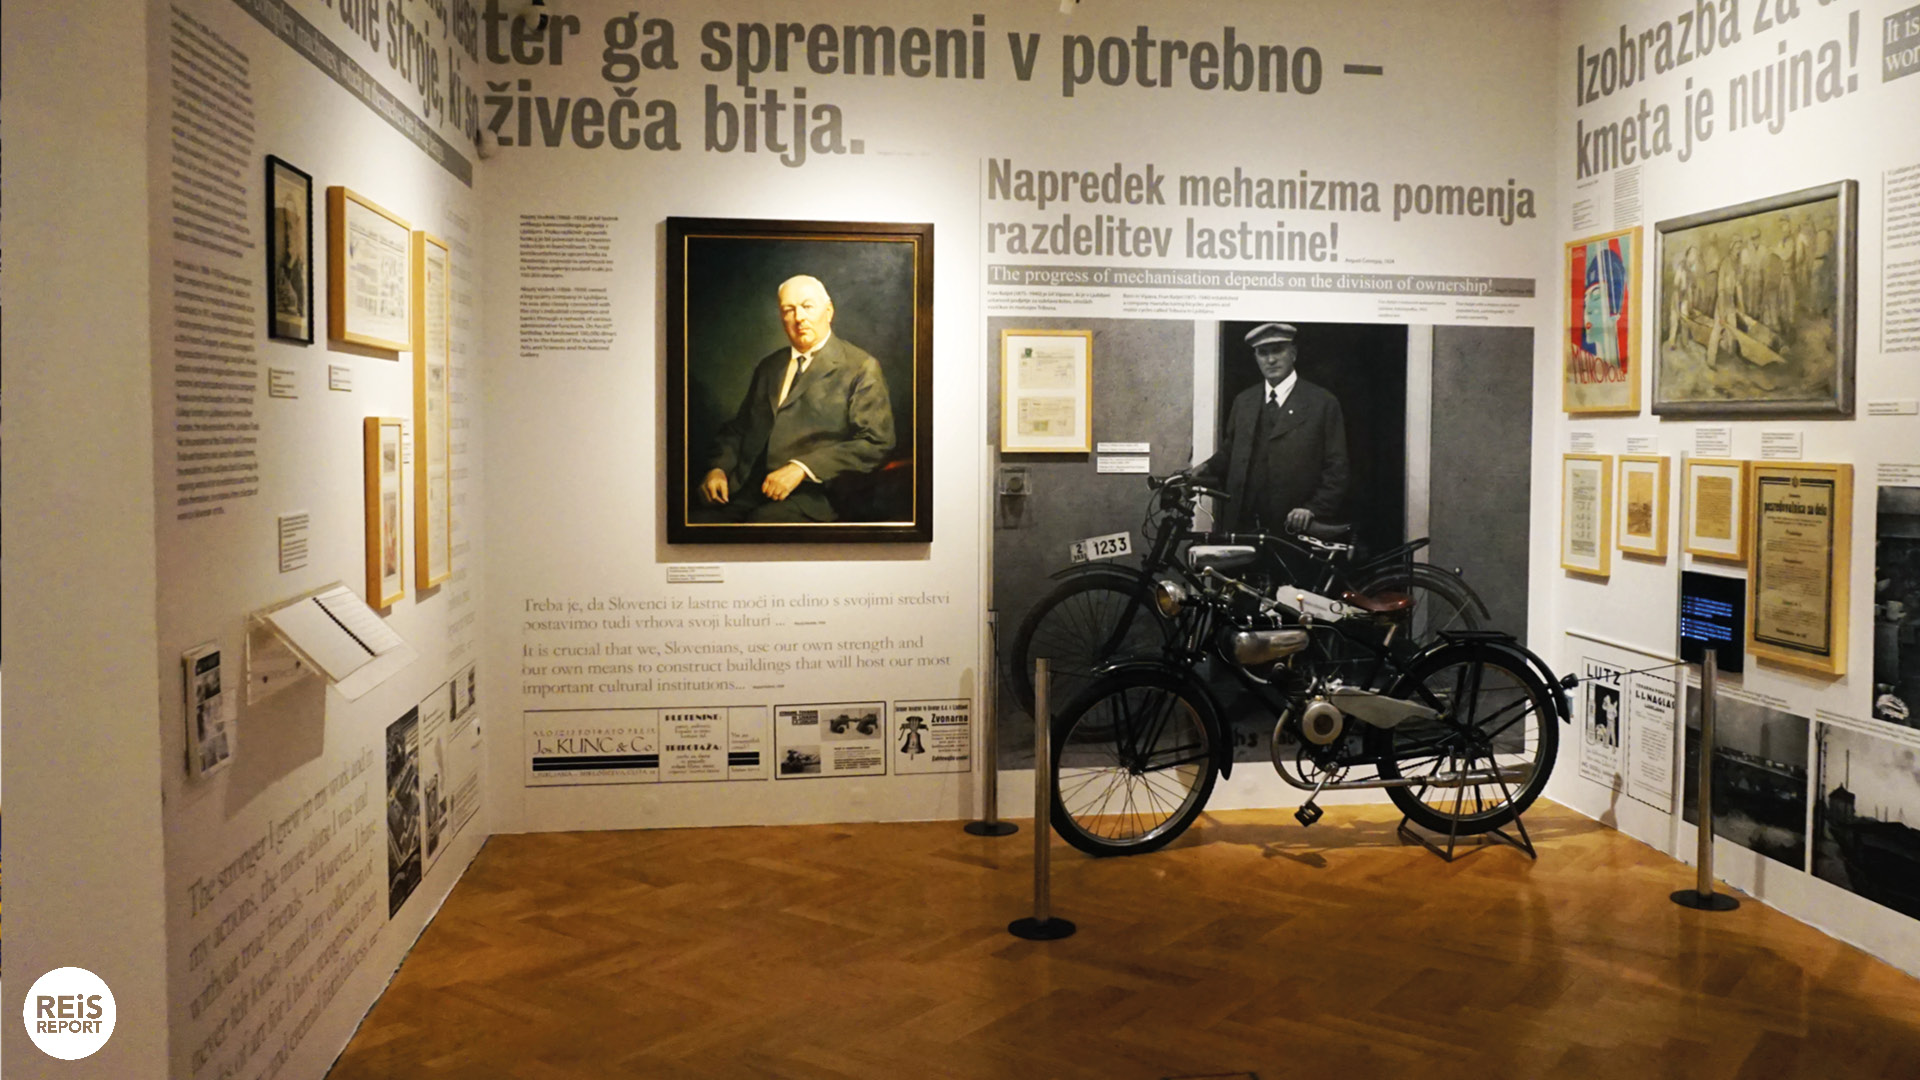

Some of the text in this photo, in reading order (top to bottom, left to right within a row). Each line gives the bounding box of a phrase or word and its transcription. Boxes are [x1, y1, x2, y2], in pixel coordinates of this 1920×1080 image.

[1886, 11, 1920, 45] It is
[482, 0, 580, 66] ter
[602, 12, 678, 84] ga
[700, 14, 985, 86] spremeni
[1008, 32, 1040, 81] v
[1062, 26, 1323, 97] potrebno
[1577, 0, 1741, 107] Izobrazba
[387, 1, 443, 128] stroje,
[449, 46, 461, 131] ki
[1577, 10, 1860, 181] kmeta je nujna!
[483, 79, 681, 151] živeča
[704, 84, 865, 168] bitja.
[987, 158, 1166, 209] Napredek
[1179, 167, 1380, 213] mehanizma
[1393, 178, 1536, 226] pomenja
[987, 214, 1339, 263] razdelitev lastnine!
[991, 266, 1020, 281] The
[1025, 270, 1089, 287] progress
[1093, 268, 1112, 284] of
[1114, 270, 1221, 286] mechanisation
[1225, 272, 1284, 290] depends
[1288, 277, 1306, 287] on
[1308, 273, 1333, 288] the
[1337, 274, 1393, 290] division
[1397, 276, 1415, 291] of
[1416, 278, 1493, 296] ownership!
[1572, 343, 1626, 384] METROPOLIS
[1076, 537, 1127, 556] 2 1233
[525, 598, 563, 612] Treba
[567, 599, 584, 613] je,
[587, 597, 604, 611] da
[608, 597, 667, 611] Slovenci
[671, 597, 683, 609] iz
[688, 596, 729, 609] lastne
[772, 595, 785, 608] in
[789, 594, 829, 608] edino
[833, 596, 839, 606] s
[844, 593, 893, 609] svojimi
[897, 592, 950, 606] sredstvi
[602, 616, 630, 629] tudi
[635, 615, 684, 629] vrhova
[688, 615, 720, 631] svoji
[724, 613, 771, 627] kulturi
[522, 636, 924, 658] It is crucial that we, Slovenians, use our own strength and
[522, 655, 951, 676] our own means to construct buildings that will host our most
[1587, 663, 1621, 687] LUTZ
[522, 678, 746, 699] important cultural institutions...
[931, 713, 968, 723] Zvonarna
[557, 737, 613, 754] KUNC
